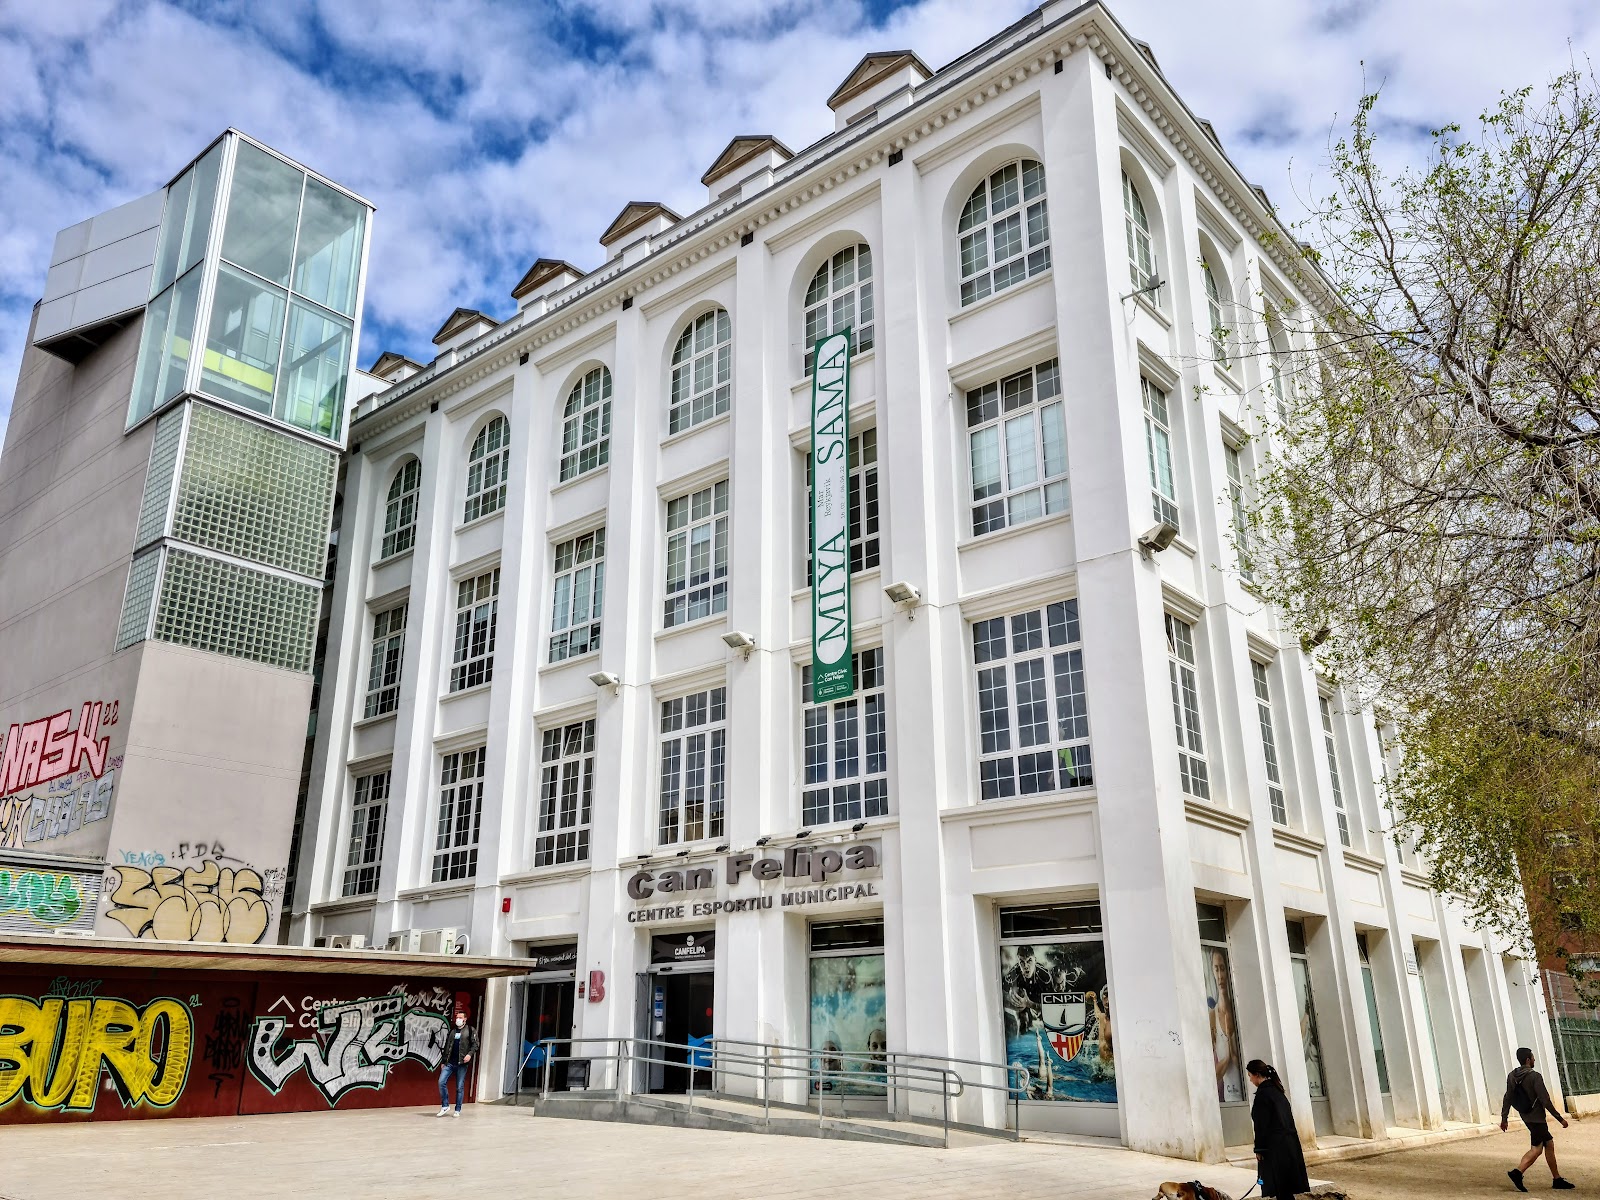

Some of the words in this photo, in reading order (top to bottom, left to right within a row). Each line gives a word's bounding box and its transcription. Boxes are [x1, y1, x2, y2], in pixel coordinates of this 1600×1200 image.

[816, 343, 846, 466] SAMA
[817, 525, 846, 648] MIYA
[627, 867, 714, 901] Can
[726, 844, 879, 885] Felipa
[628, 905, 685, 923] CENTRE
[692, 896, 773, 917] ESPORTIU
[781, 883, 878, 907] MUNICIPAL
[1043, 994, 1084, 1004] CNPN
